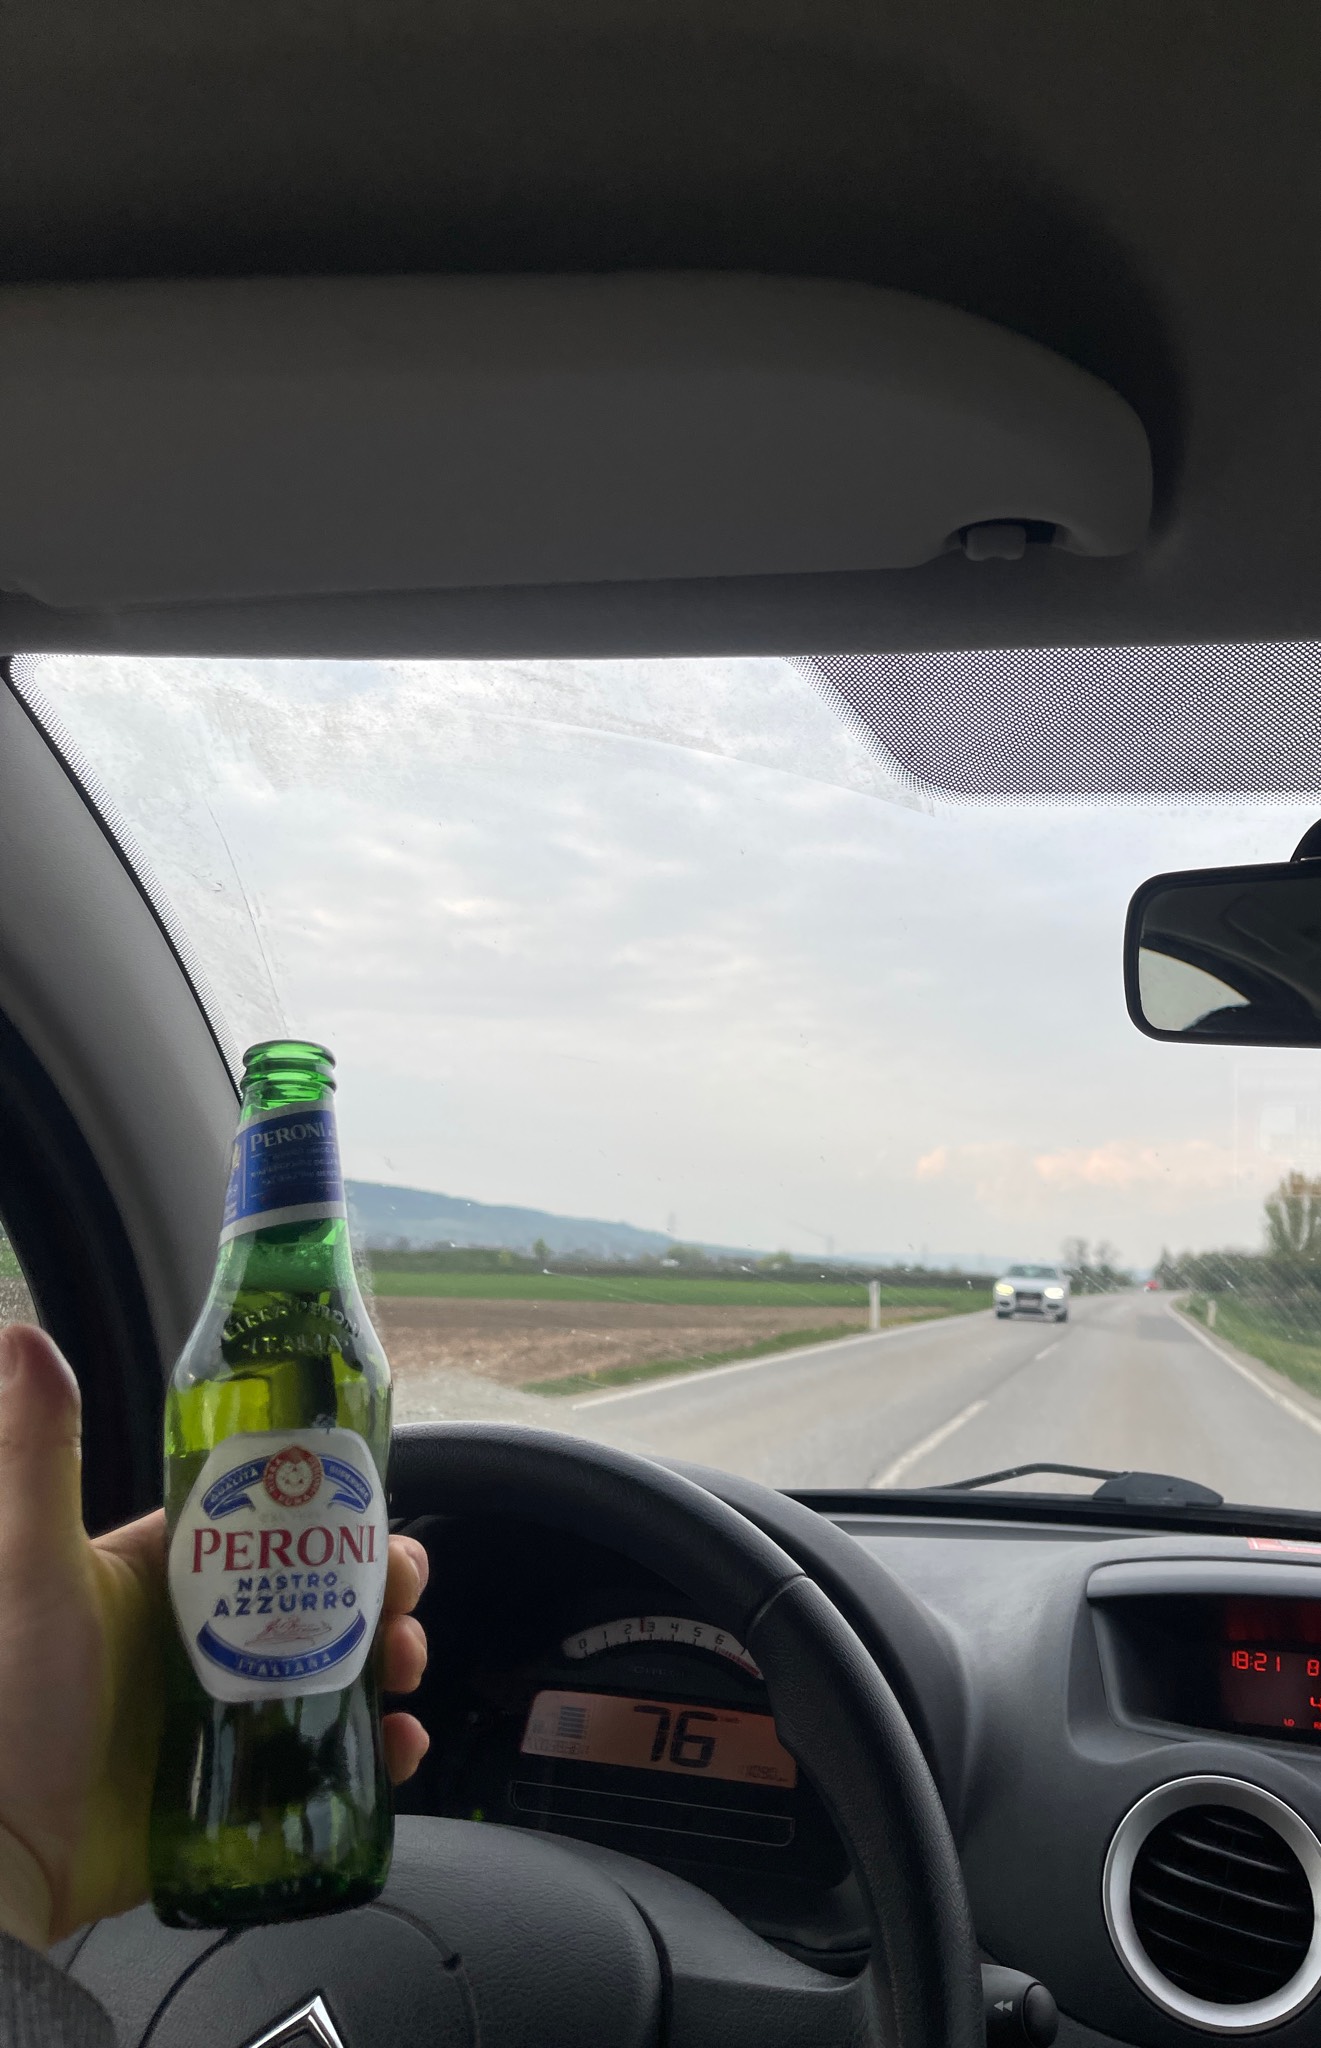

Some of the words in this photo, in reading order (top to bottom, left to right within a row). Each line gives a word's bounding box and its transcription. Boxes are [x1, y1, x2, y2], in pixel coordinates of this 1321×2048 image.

[250, 1121, 325, 1152] PERONI
[192, 1524, 377, 1573] PERONI
[237, 1571, 338, 1592] NASTRO
[213, 1588, 357, 1617] AZZURRO
[578, 1638, 587, 1649] 0
[623, 1623, 633, 1635] 2
[647, 1621, 656, 1633] 3
[670, 1622, 680, 1633] 4
[693, 1626, 703, 1638] 5
[714, 1633, 726, 1645] 6
[237, 1652, 332, 1677] ITALIANA
[633, 1703, 718, 1769] 76
